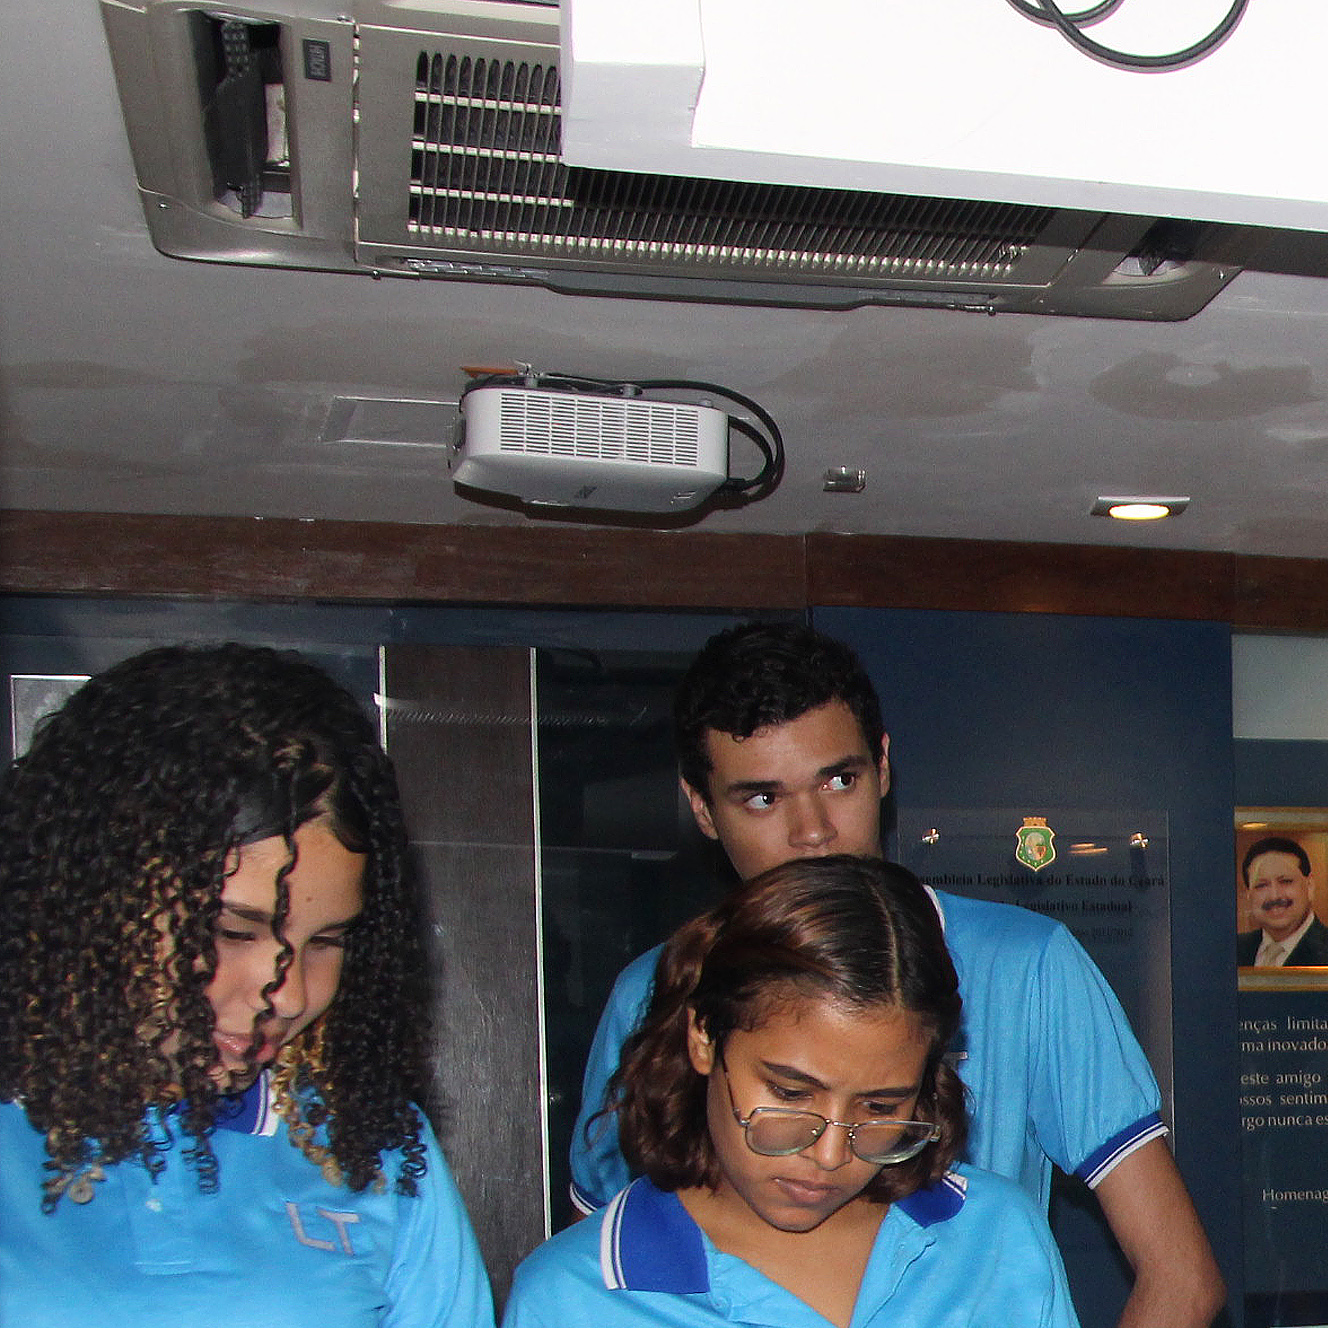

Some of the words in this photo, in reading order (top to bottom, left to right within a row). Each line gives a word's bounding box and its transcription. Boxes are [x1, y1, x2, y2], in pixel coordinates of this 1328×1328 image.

[1276, 1071, 1321, 1087] amigo
[1268, 1115, 1313, 1127] nunca
[286, 1201, 360, 1256] LT
